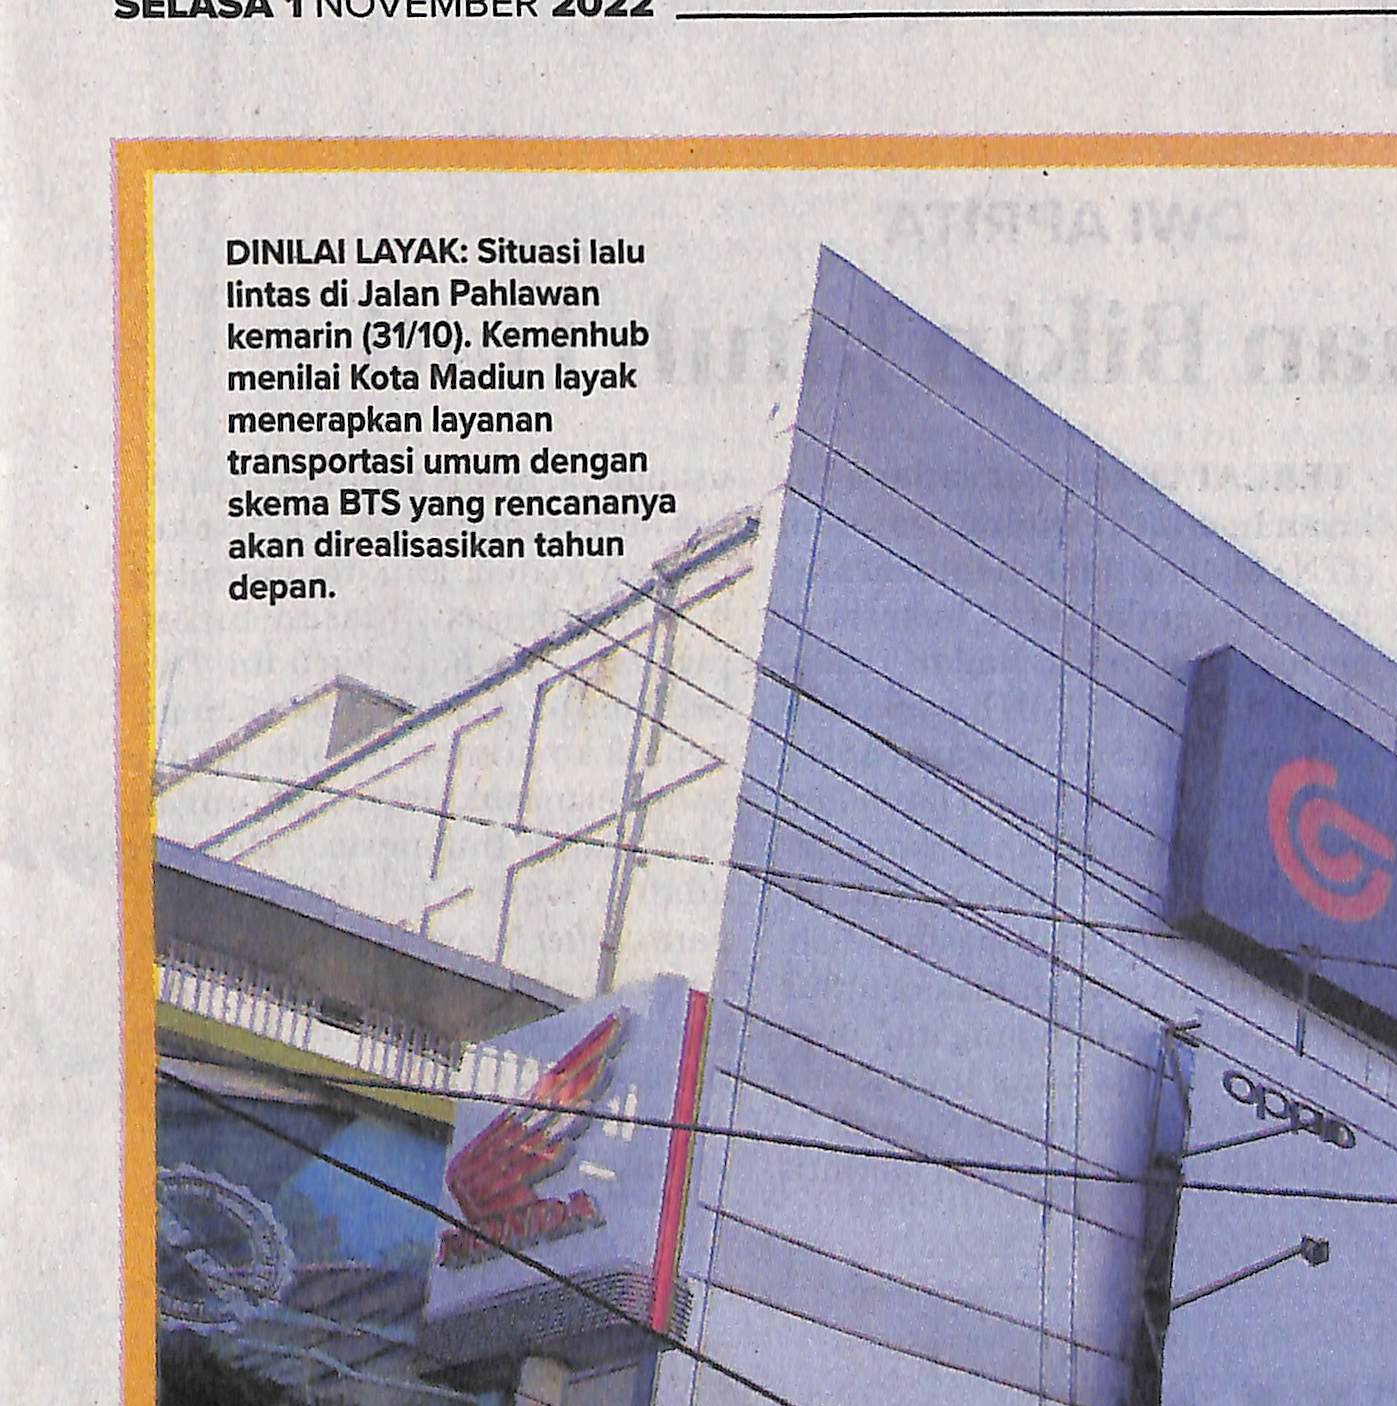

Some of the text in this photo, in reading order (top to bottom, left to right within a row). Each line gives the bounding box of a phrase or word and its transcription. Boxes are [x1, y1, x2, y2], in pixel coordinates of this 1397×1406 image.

[114, 0, 654, 20] SELASA 1 NOVEMBER 2022
[227, 236, 645, 266] DINILAI LAYAK: Situasi lalu
[227, 278, 600, 308] lintas di Jalan Pahlawan
[228, 319, 649, 356] kemarin (31/10). Kemenhub
[228, 361, 637, 397] menilai Kota Madiun layak
[228, 405, 553, 440] menerapkan layanan
[226, 446, 648, 481] transportasi umum dengan
[228, 488, 676, 524] skema BTS yang rencananya
[228, 529, 624, 560] akan direalisasikan tahun
[228, 573, 336, 606] depan.
